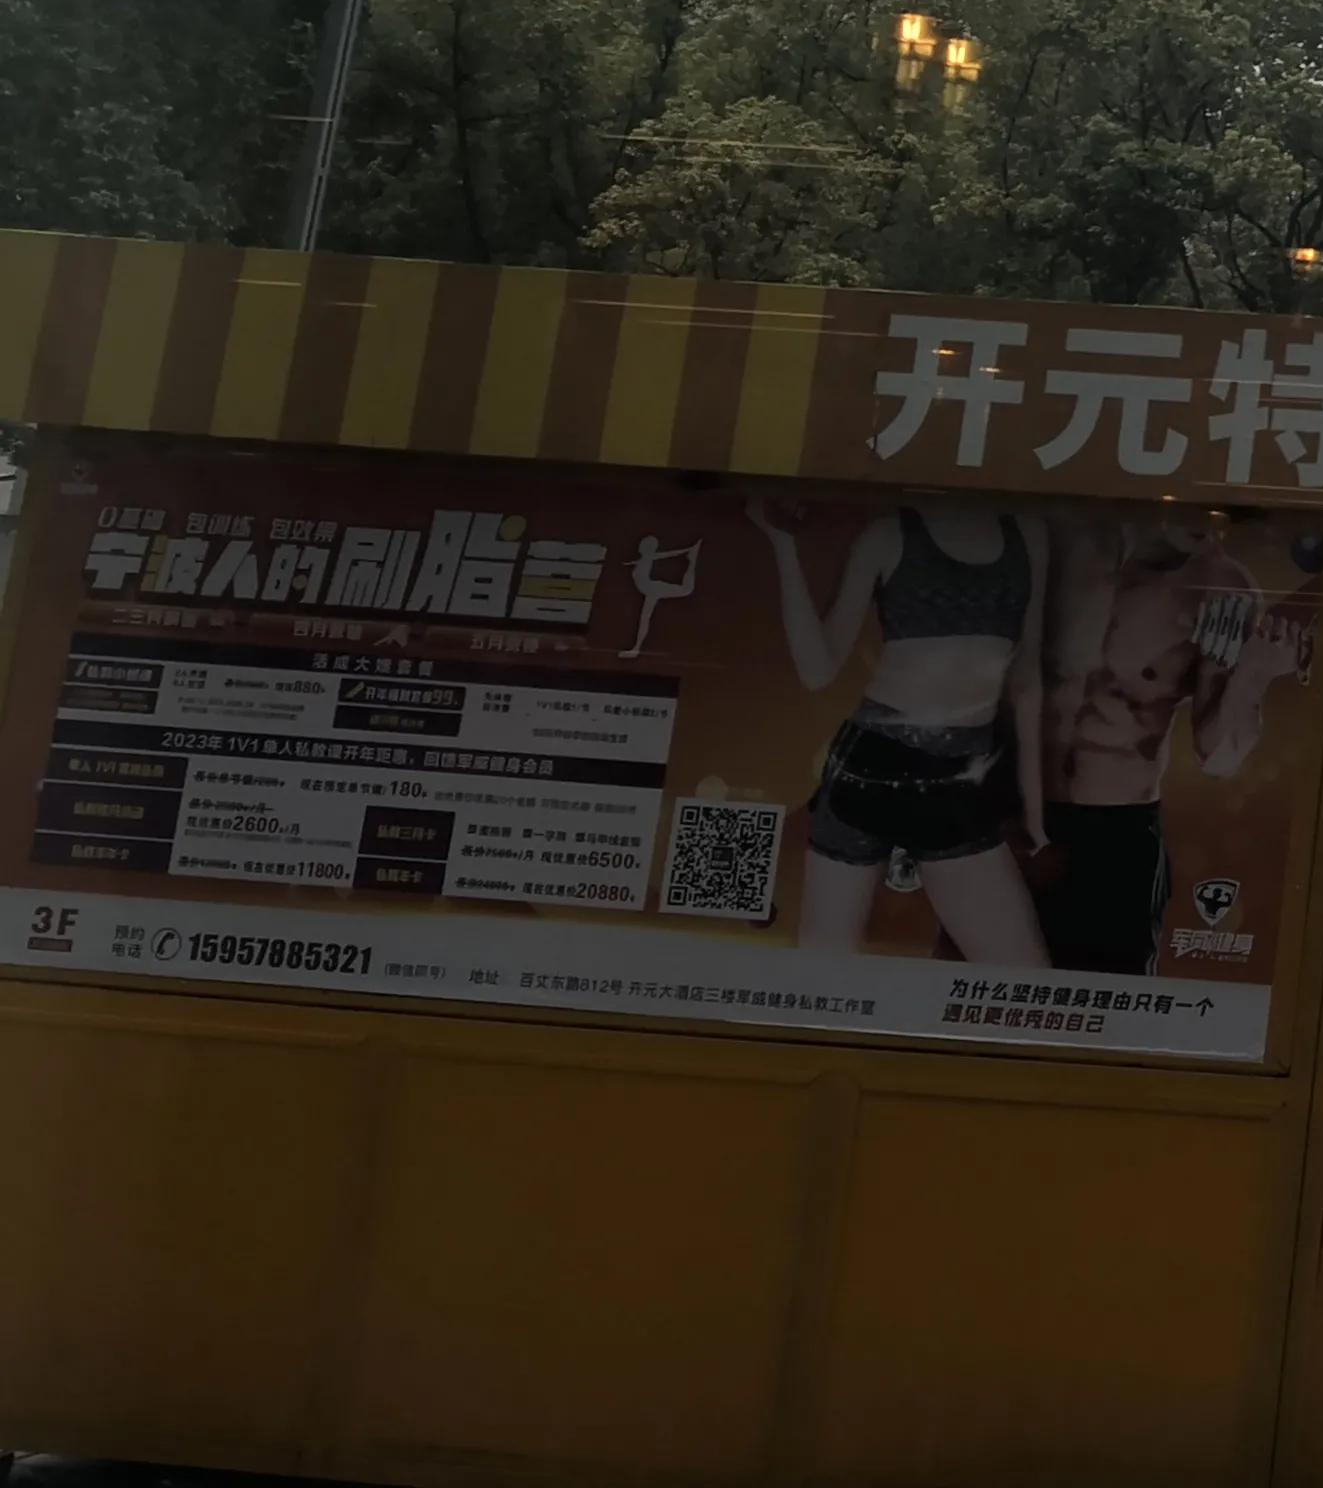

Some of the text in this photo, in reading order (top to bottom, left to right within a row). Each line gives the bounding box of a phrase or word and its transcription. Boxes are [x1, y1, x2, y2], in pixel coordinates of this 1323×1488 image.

[84, 509, 608, 625] 宁波人的刷脂营
[160, 731, 223, 751] 2023年
[31, 906, 79, 936] 3F
[114, 924, 145, 941] 预约
[112, 942, 142, 959] 电话
[188, 933, 373, 975] 15957885321
[950, 977, 1215, 1017] 为什么坚持健身理由只有一个
[942, 1003, 1105, 1034] 遇见更优秀的自己
